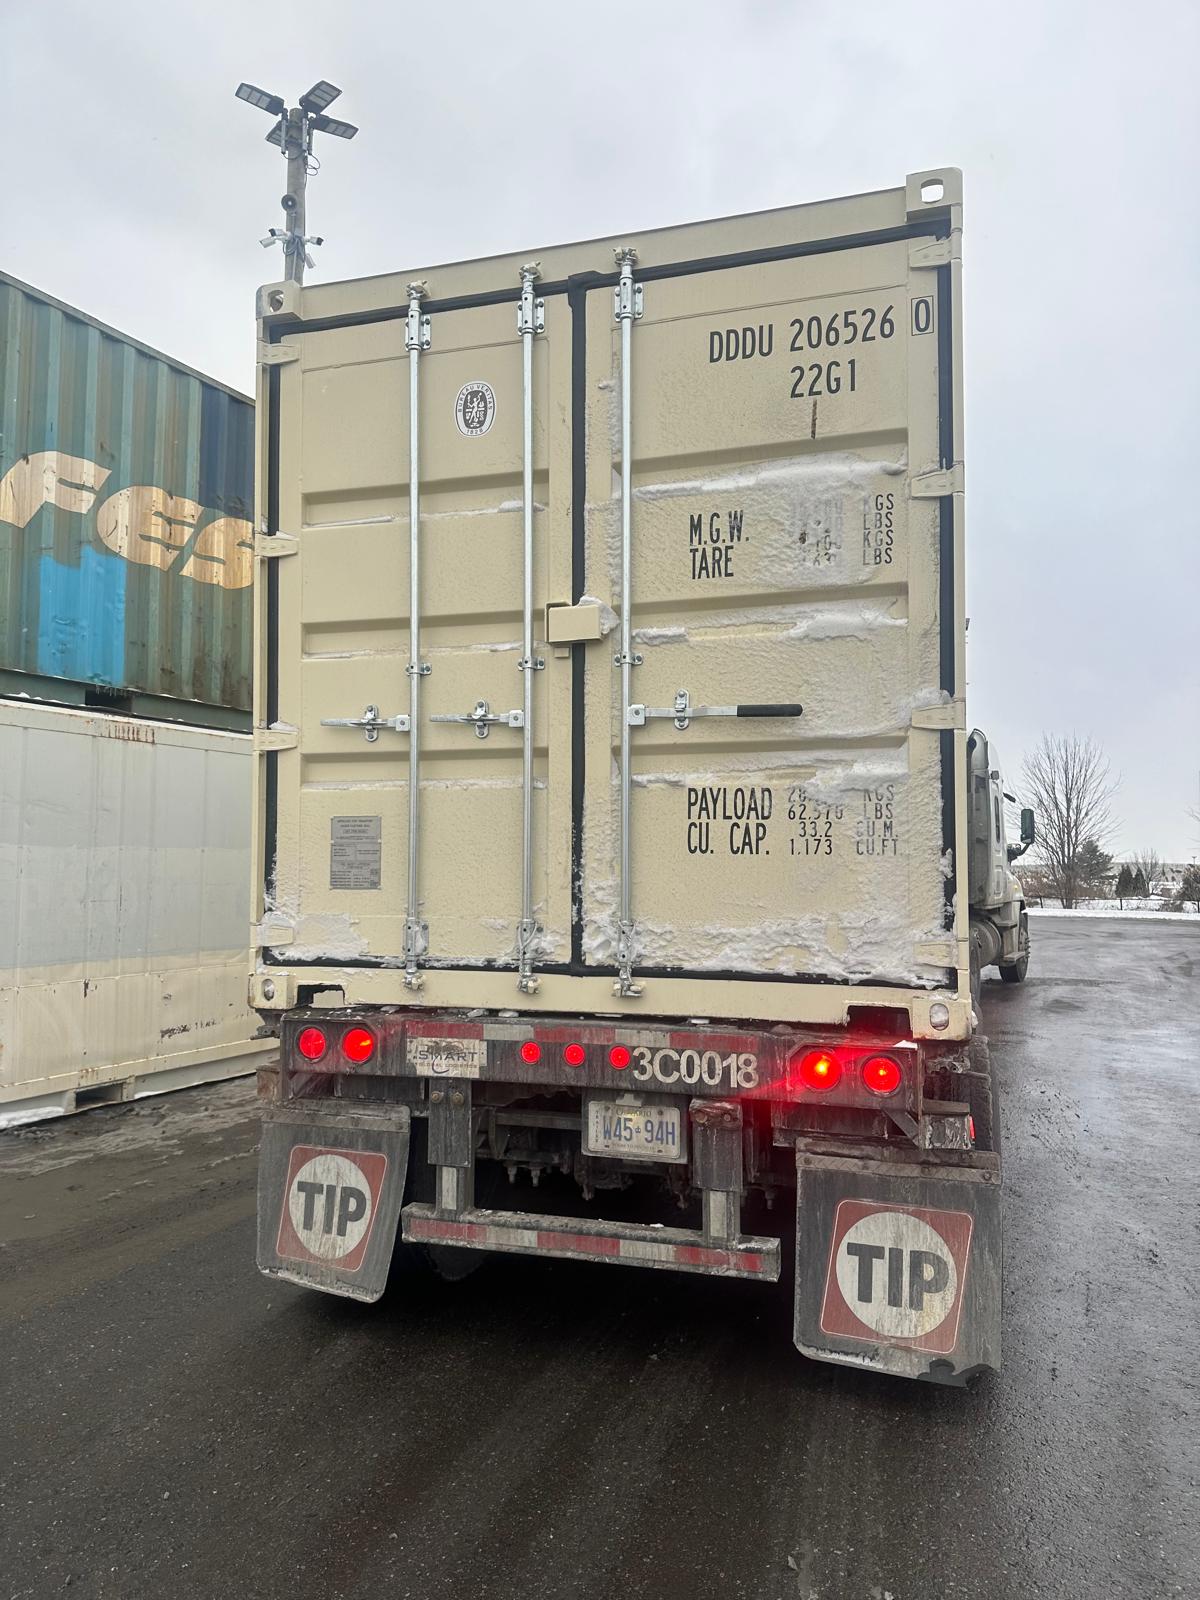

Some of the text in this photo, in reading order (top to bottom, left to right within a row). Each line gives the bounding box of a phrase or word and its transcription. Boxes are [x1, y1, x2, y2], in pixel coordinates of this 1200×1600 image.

[709, 298, 931, 363] DDDU 206526 0
[790, 358, 856, 399] 22G1
[458, 385, 493, 413] BUREAU VERITAS
[689, 510, 750, 546] M.G.W.
[863, 512, 893, 530] LBS
[863, 530, 894, 548] KGS
[690, 545, 734, 580] TARE
[862, 547, 892, 565] LBS
[687, 787, 772, 820] PAYLOAD
[863, 803, 894, 819] LBS
[687, 822, 714, 854] CU.
[729, 822, 770, 855] CAP.
[798, 821, 832, 838] 33.2
[419, 1050, 478, 1062] SMART
[632, 1046, 759, 1089] 3C0018
[603, 1115, 676, 1146] W45 94H
[297, 1180, 367, 1237] TIP
[847, 1242, 950, 1312] TIP
